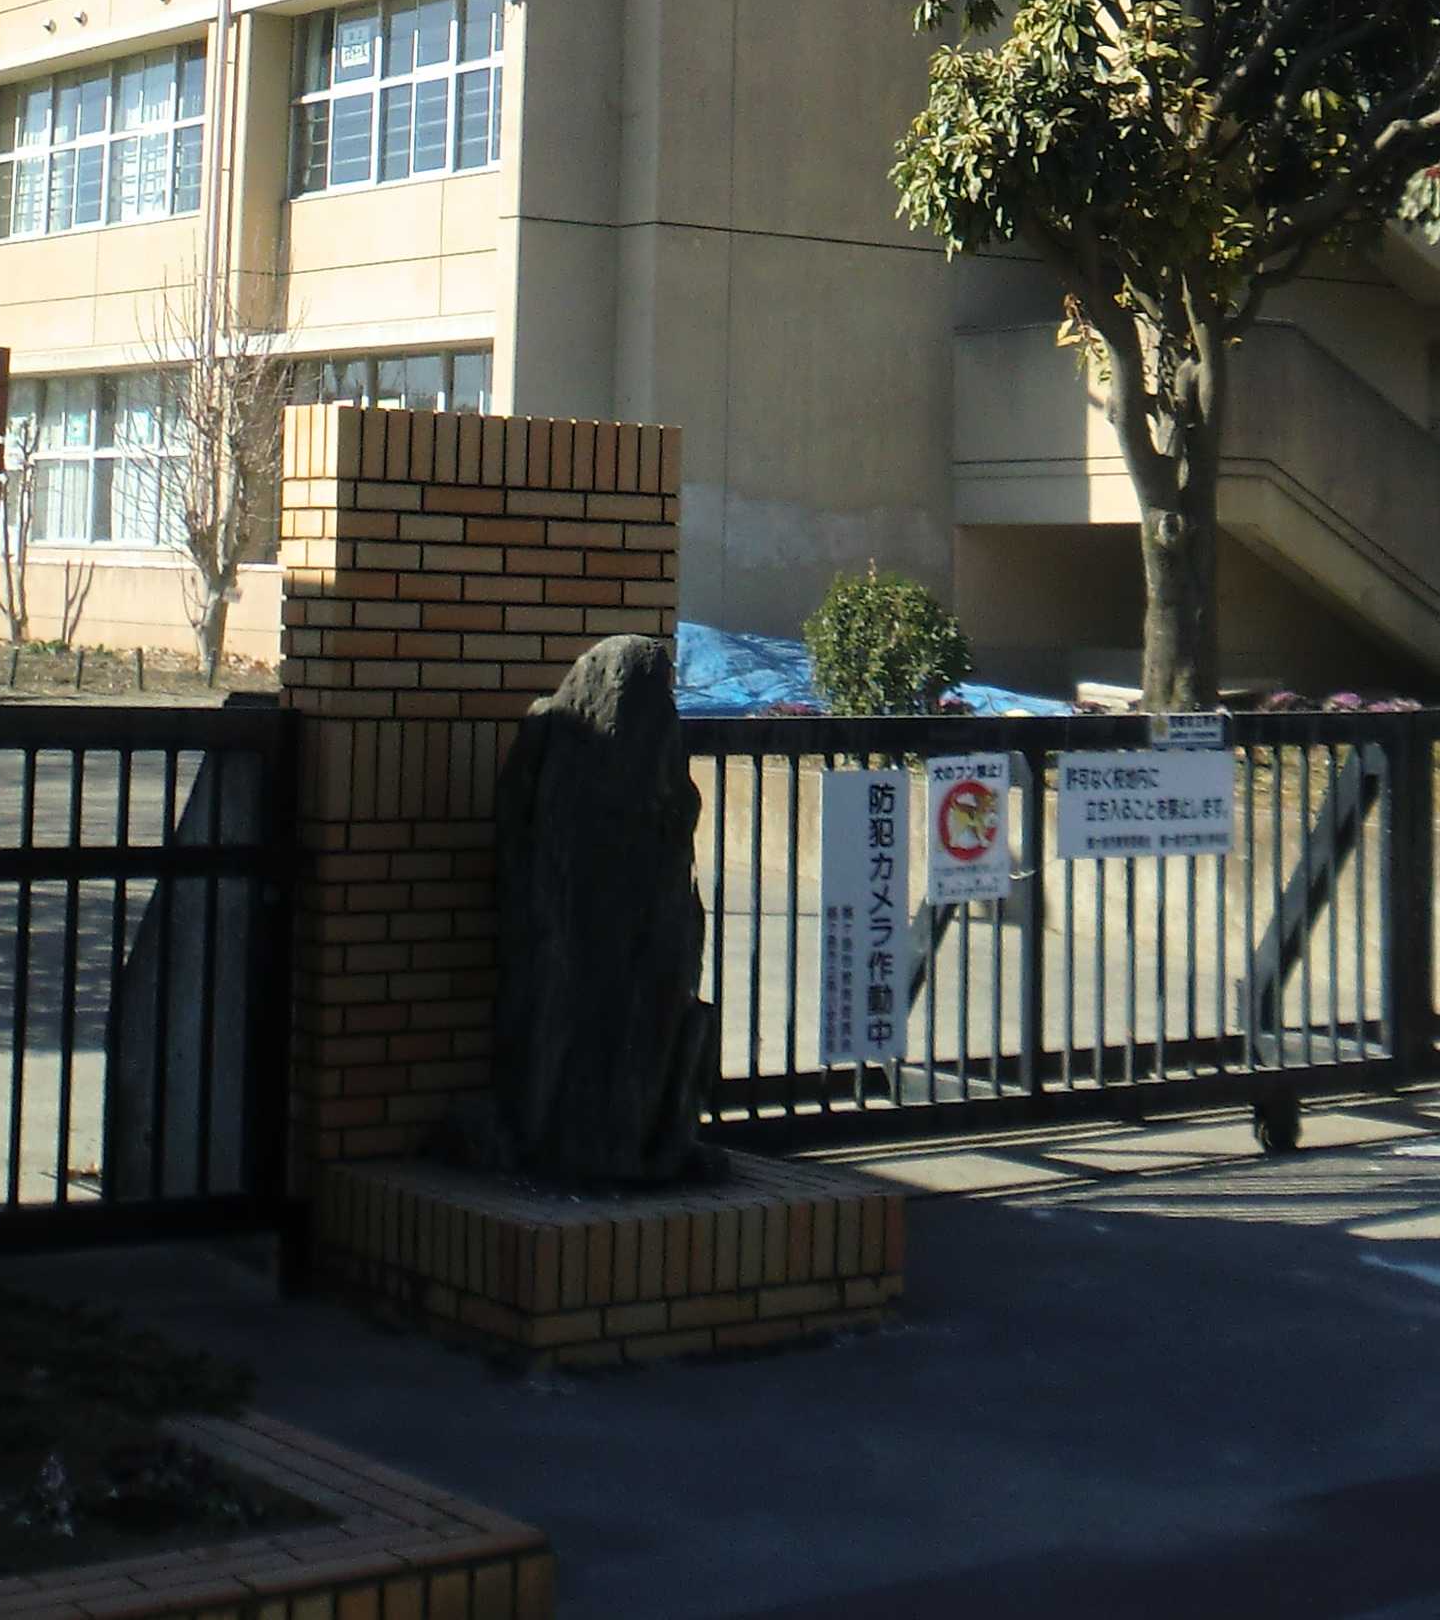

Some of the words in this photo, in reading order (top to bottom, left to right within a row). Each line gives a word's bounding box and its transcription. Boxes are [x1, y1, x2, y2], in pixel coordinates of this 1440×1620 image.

[868, 784, 896, 1049] 防犯カメラ作動中
